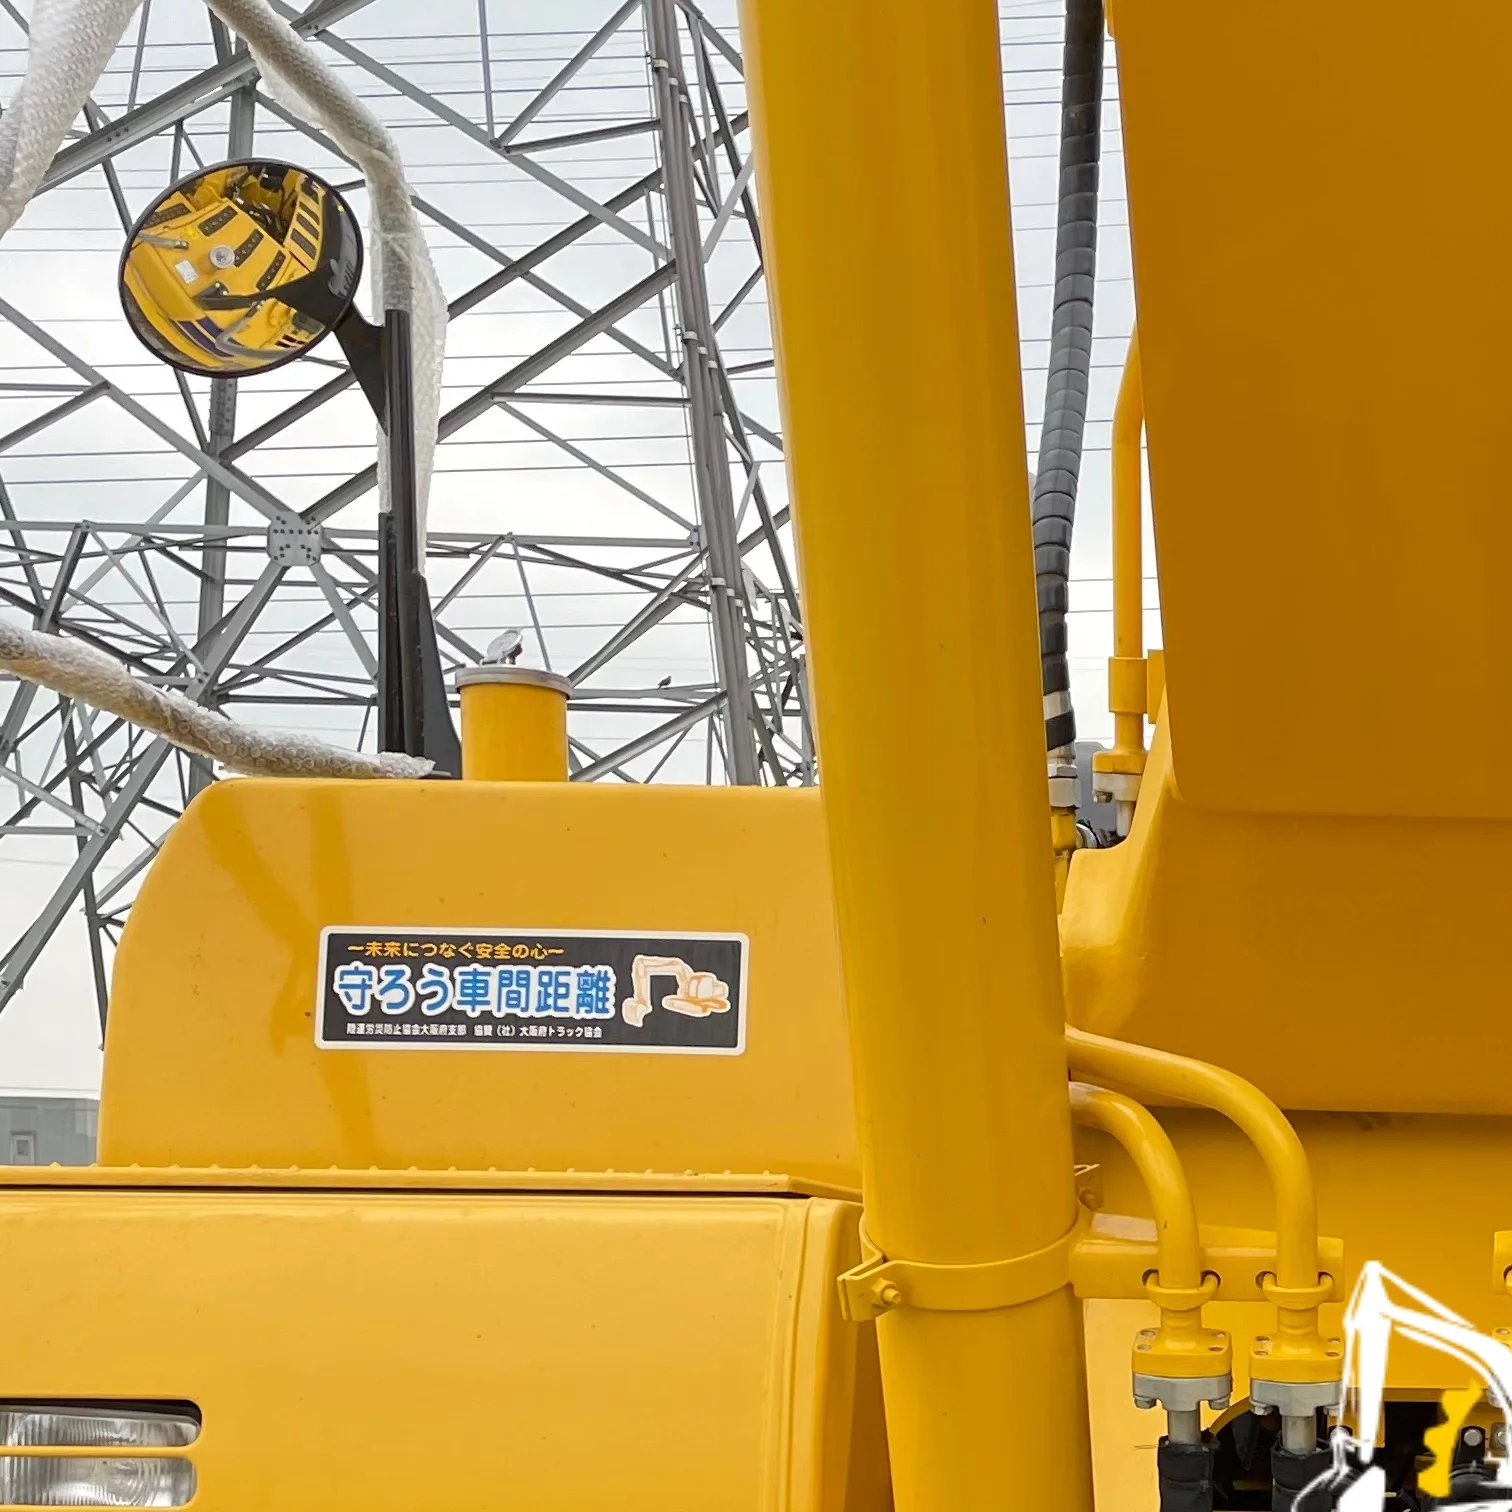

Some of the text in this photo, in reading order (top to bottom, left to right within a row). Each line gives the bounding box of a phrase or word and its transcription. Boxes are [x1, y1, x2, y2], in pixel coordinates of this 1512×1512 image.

[336, 963, 615, 1017] 守ろう車間距離
